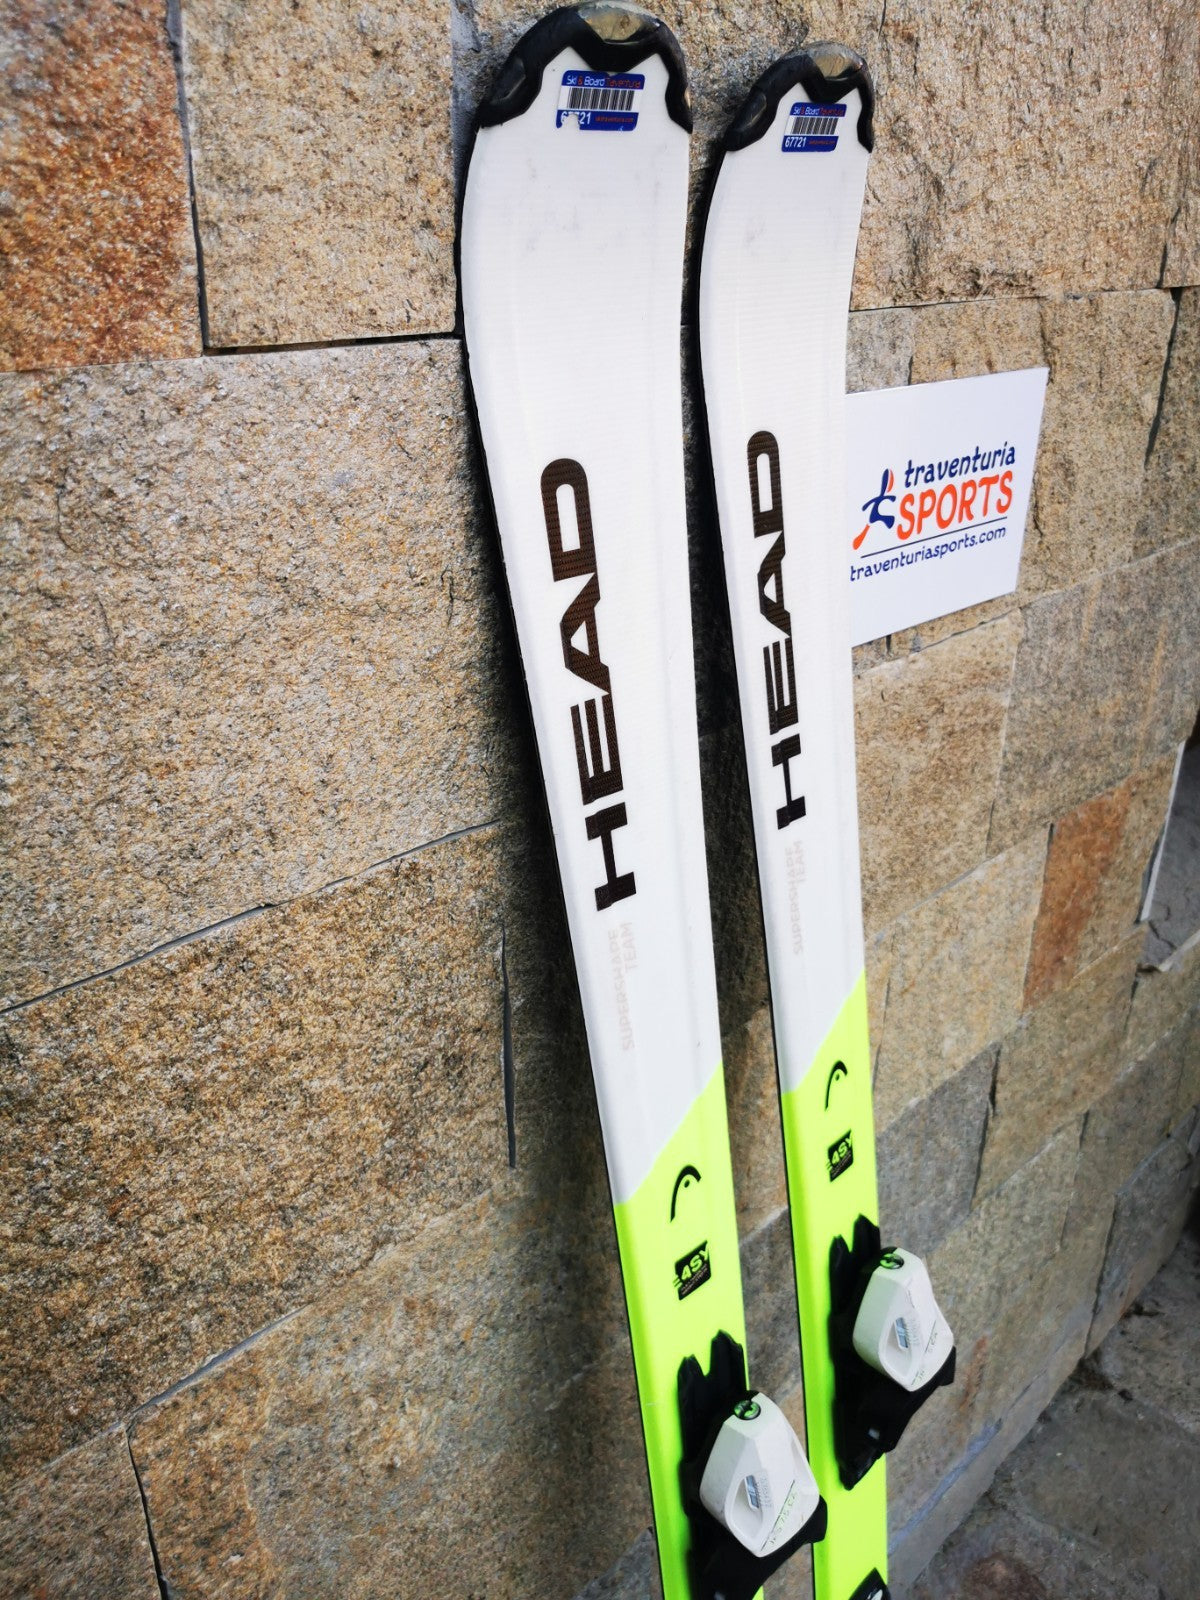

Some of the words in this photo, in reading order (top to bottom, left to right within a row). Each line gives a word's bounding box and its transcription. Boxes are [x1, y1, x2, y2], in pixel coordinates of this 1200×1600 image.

[566, 75, 577, 86] Ski
[584, 76, 606, 87] Board
[560, 111, 592, 126] 621
[805, 106, 821, 116] Board
[784, 136, 807, 148] 67721
[904, 440, 1016, 489] traventuria
[896, 470, 1013, 541] SPORTS
[850, 525, 1006, 582] traventuriasports.com
[747, 430, 806, 831] HEAD
[540, 457, 637, 912] HEAD
[619, 921, 638, 974] TEAM
[607, 929, 635, 1052] SUPERSHAPE
